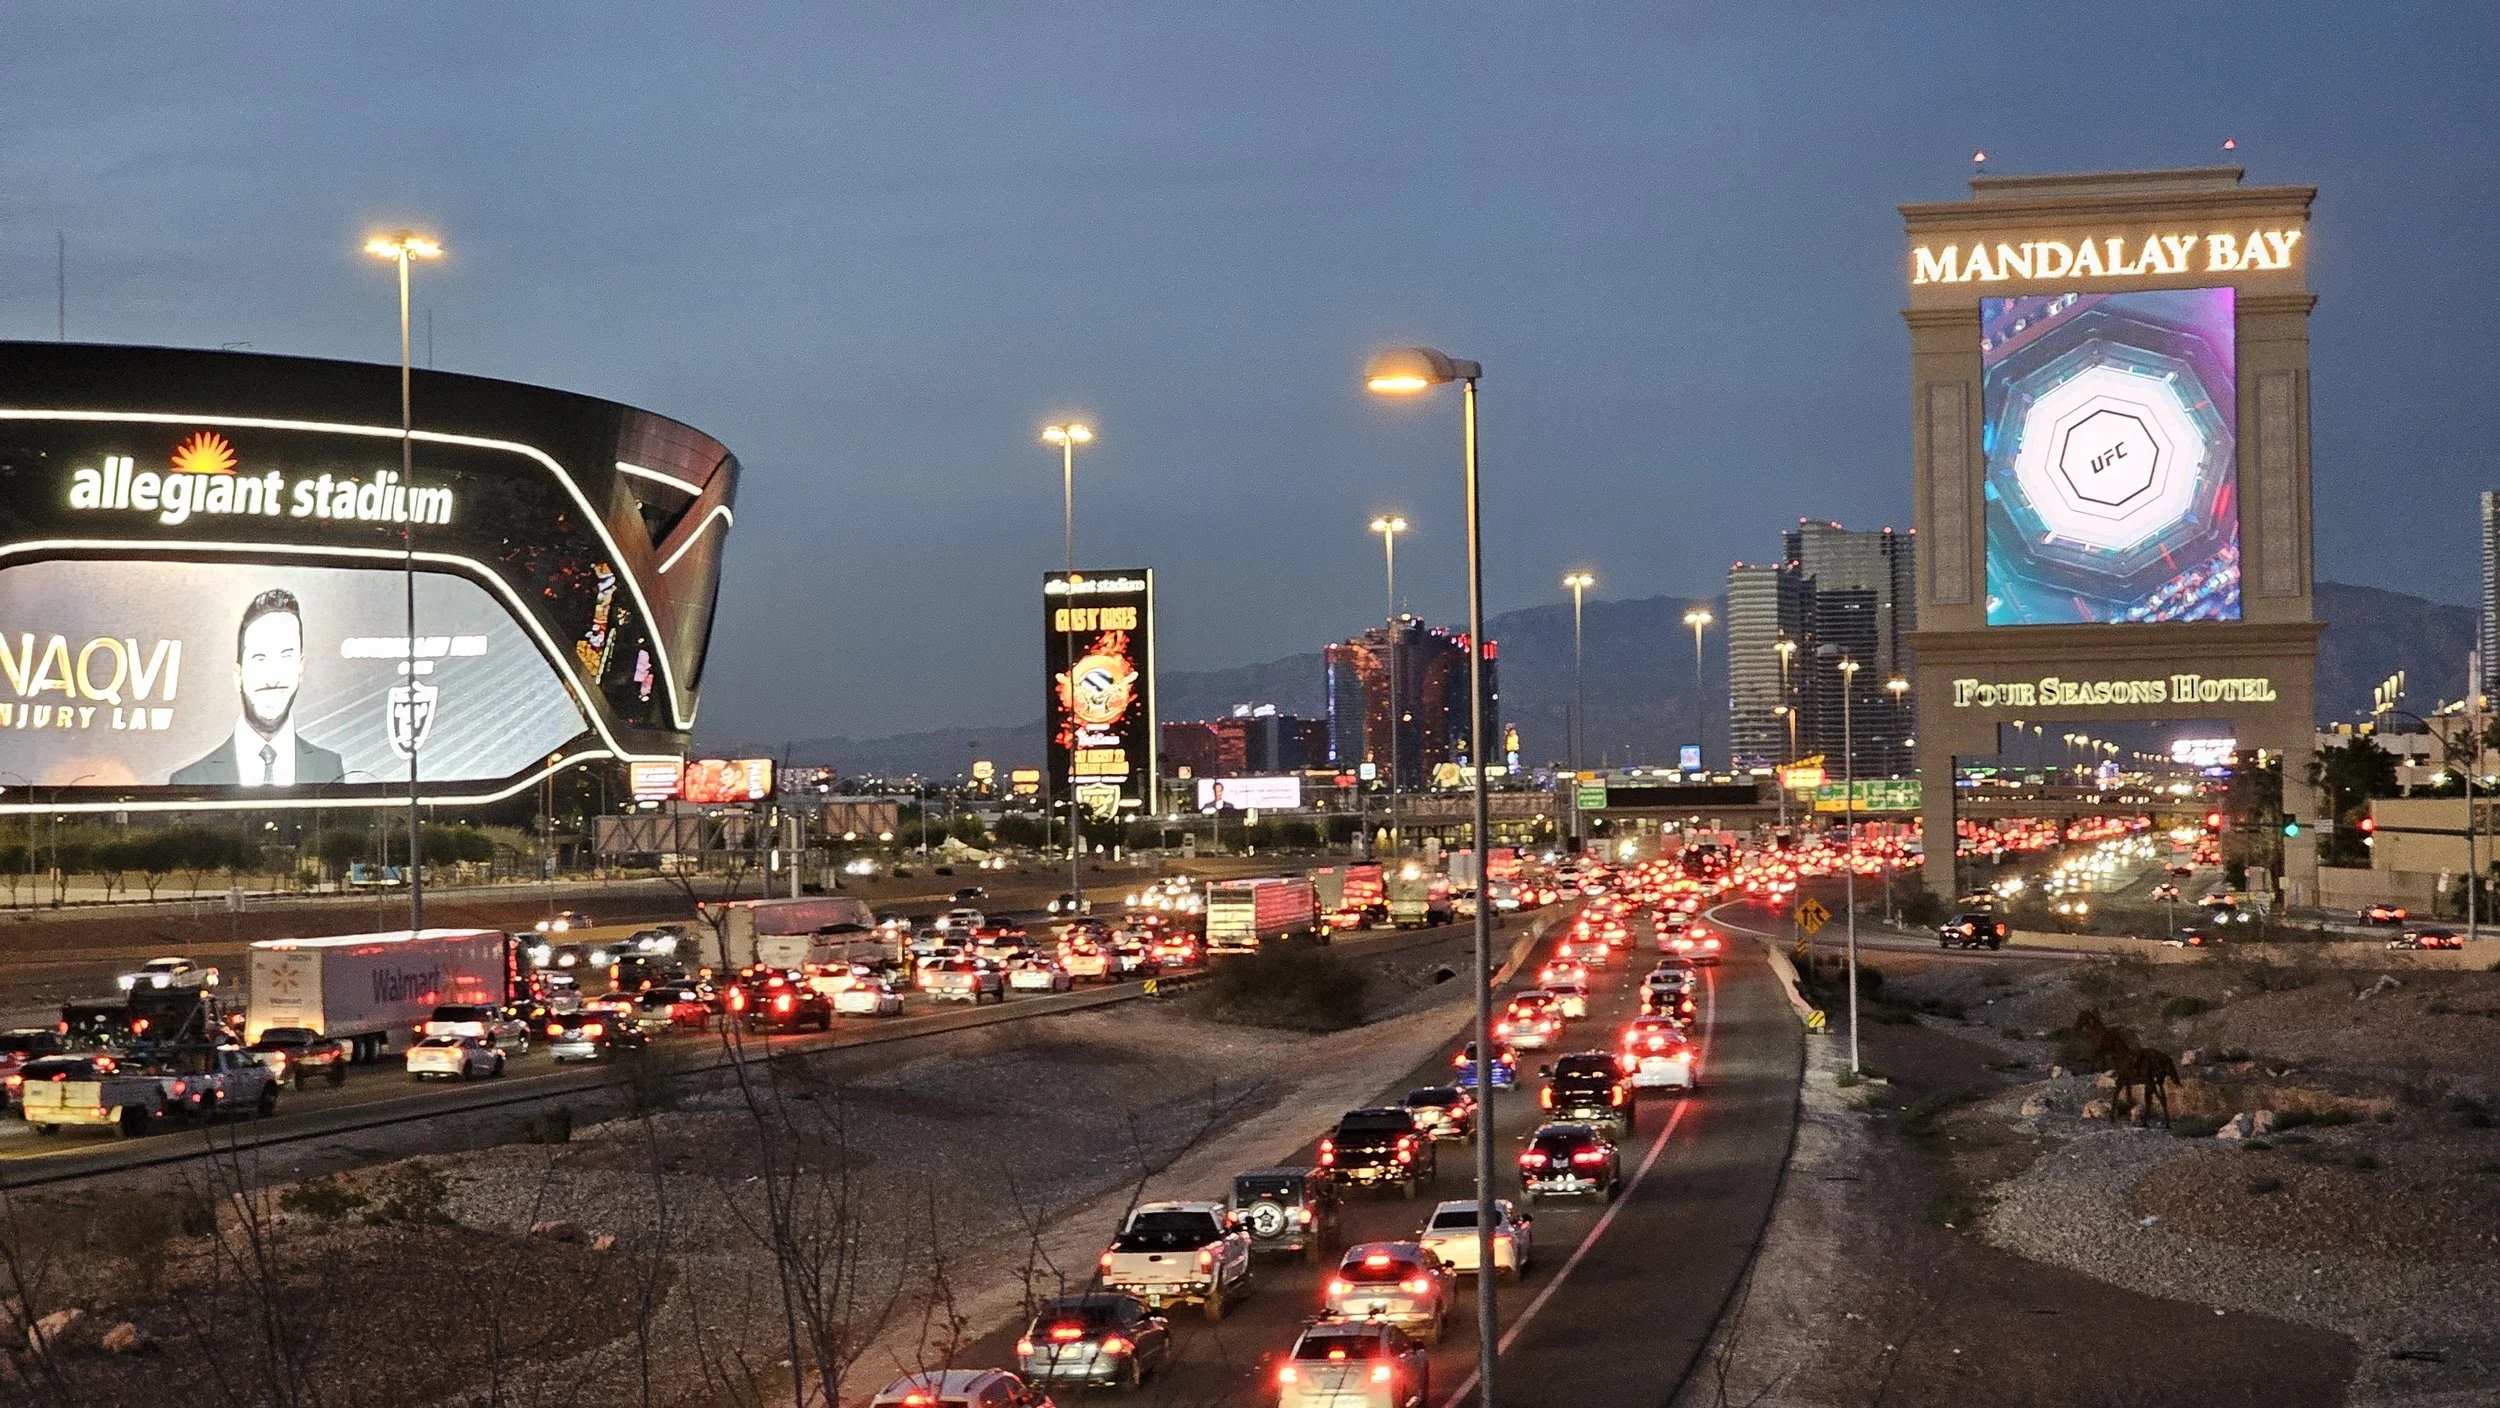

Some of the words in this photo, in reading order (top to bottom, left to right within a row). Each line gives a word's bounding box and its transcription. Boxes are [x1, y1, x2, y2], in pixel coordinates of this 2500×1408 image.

[1911, 233, 2199, 285] MANDALAY
[2203, 229, 2301, 272] BAY
[2090, 441, 2128, 474] UFC
[69, 456, 286, 526] allegiant
[291, 469, 454, 525] stadium
[0, 632, 183, 705] NAQVI
[1953, 678, 2037, 707] FOUR
[2039, 677, 2167, 705] SEASONS
[2170, 674, 2277, 702] HOTEL
[0, 703, 97, 730] NJURY
[112, 707, 175, 731] LAW
[372, 964, 440, 1004] Walmart
